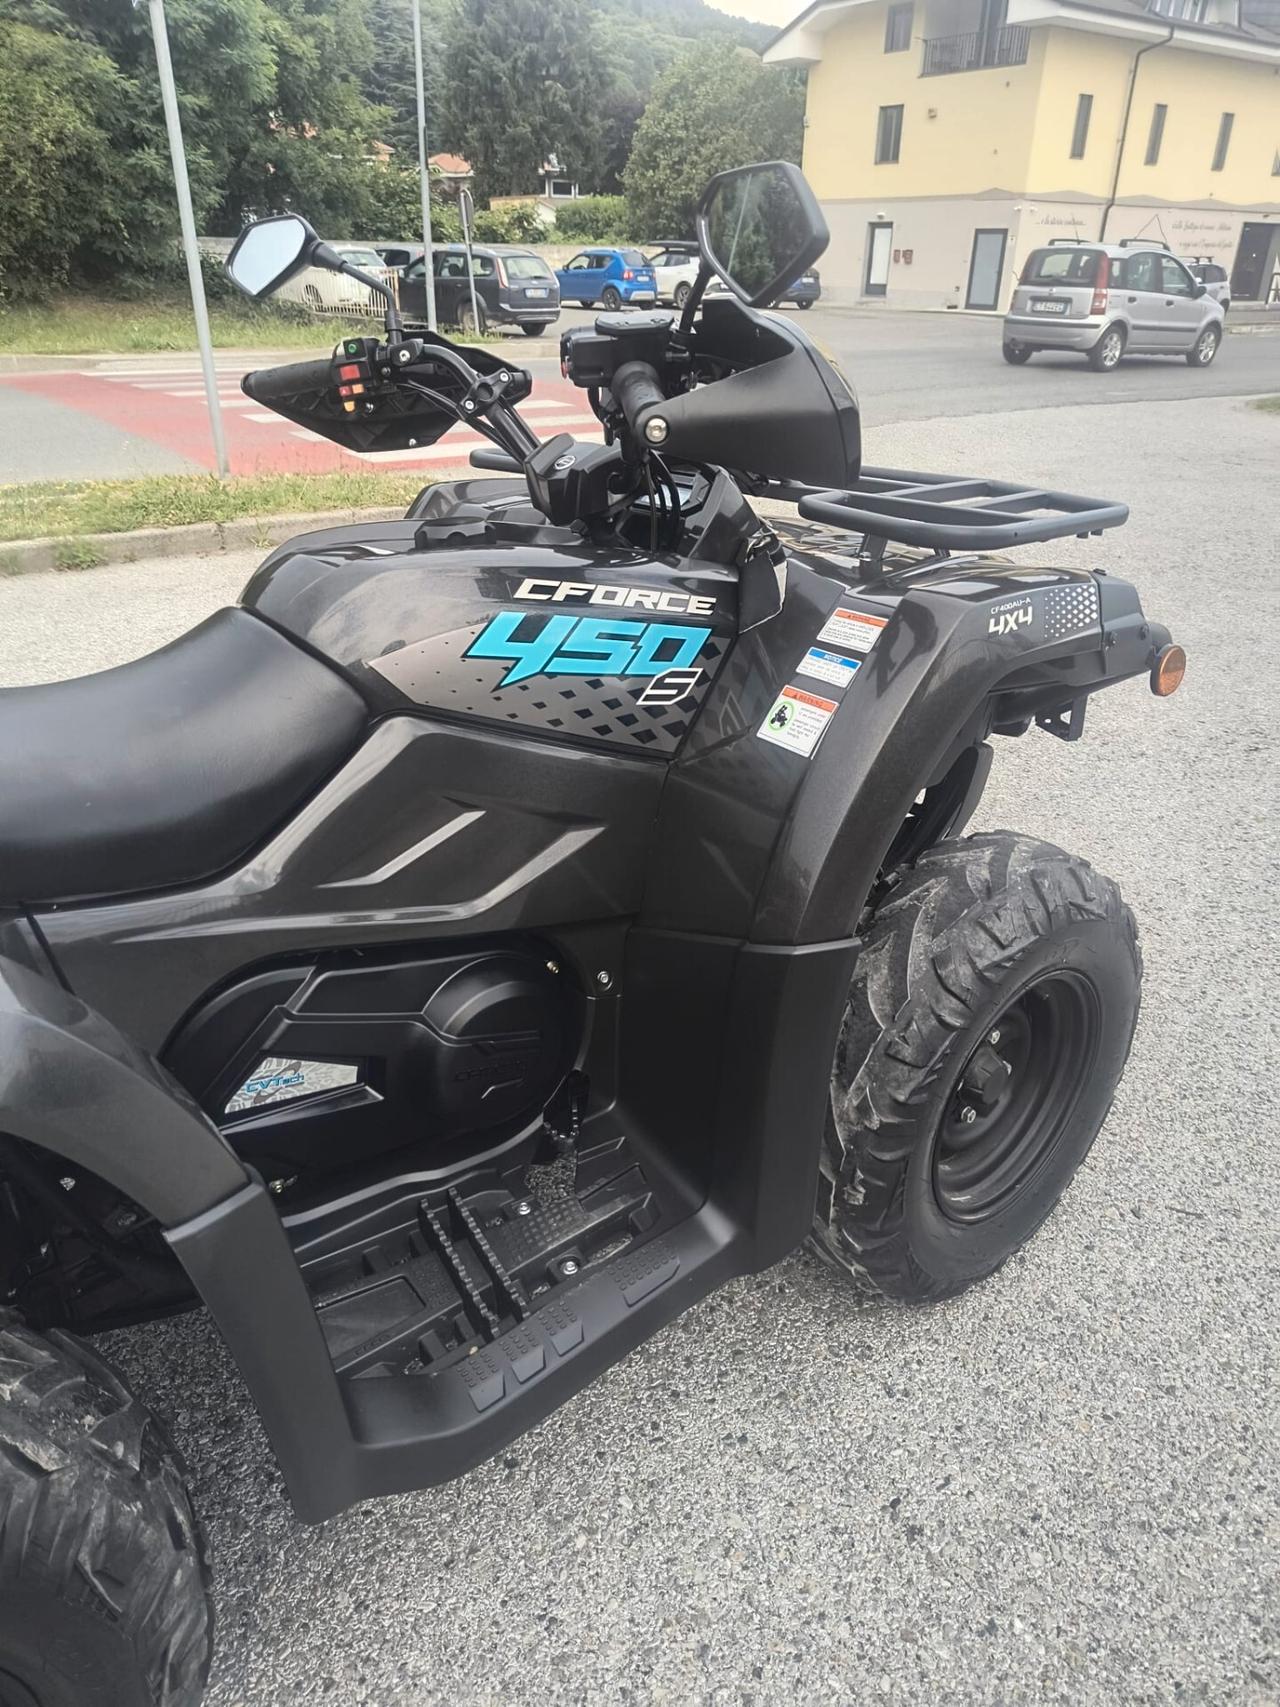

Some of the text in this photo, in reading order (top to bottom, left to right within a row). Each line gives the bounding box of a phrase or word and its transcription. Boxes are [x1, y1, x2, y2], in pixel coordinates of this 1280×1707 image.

[513, 578, 717, 615] CFORCE
[464, 611, 712, 689] 450
[636, 667, 704, 706] S
